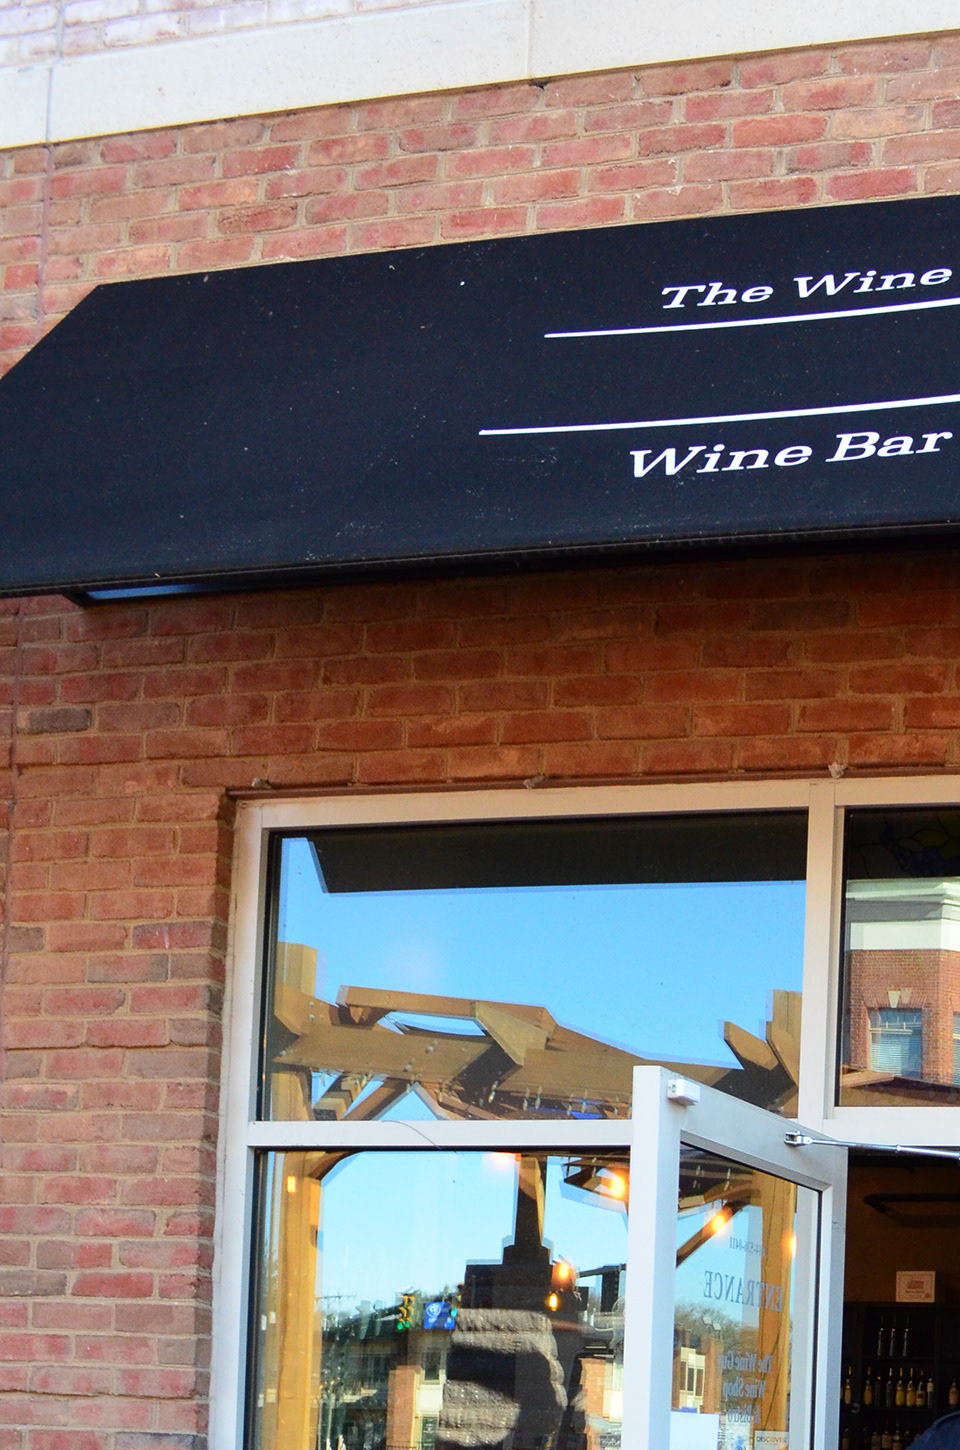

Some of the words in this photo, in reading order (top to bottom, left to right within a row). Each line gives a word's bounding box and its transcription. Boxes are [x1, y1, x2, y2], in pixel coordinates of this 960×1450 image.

[660, 282, 774, 310] The
[792, 268, 953, 299] Wine
[629, 443, 813, 478] Wine
[825, 431, 953, 462] Bar
[756, 1435, 787, 1444] DISCOVER
